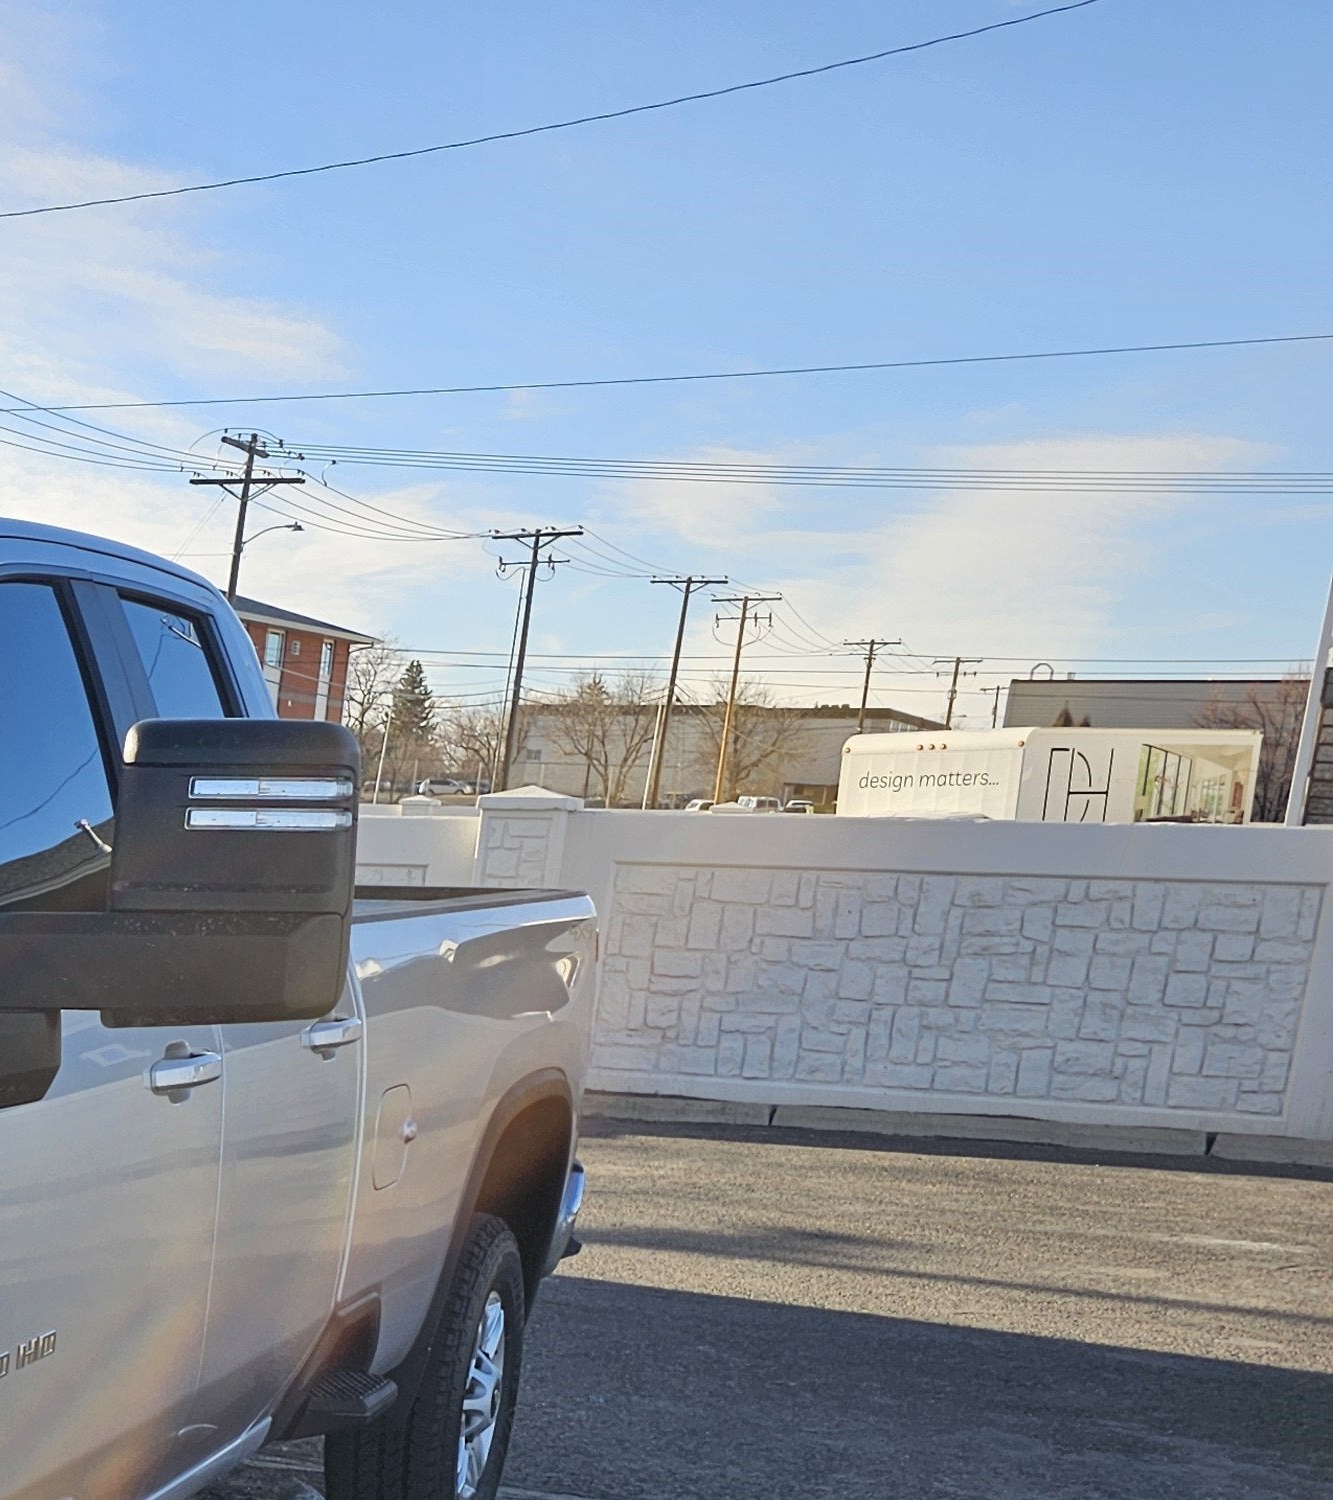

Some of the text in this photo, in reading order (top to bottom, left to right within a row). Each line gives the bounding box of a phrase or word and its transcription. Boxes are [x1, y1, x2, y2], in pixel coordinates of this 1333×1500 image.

[859, 771, 999, 793] design matters...
[16, 1329, 56, 1370] HD
